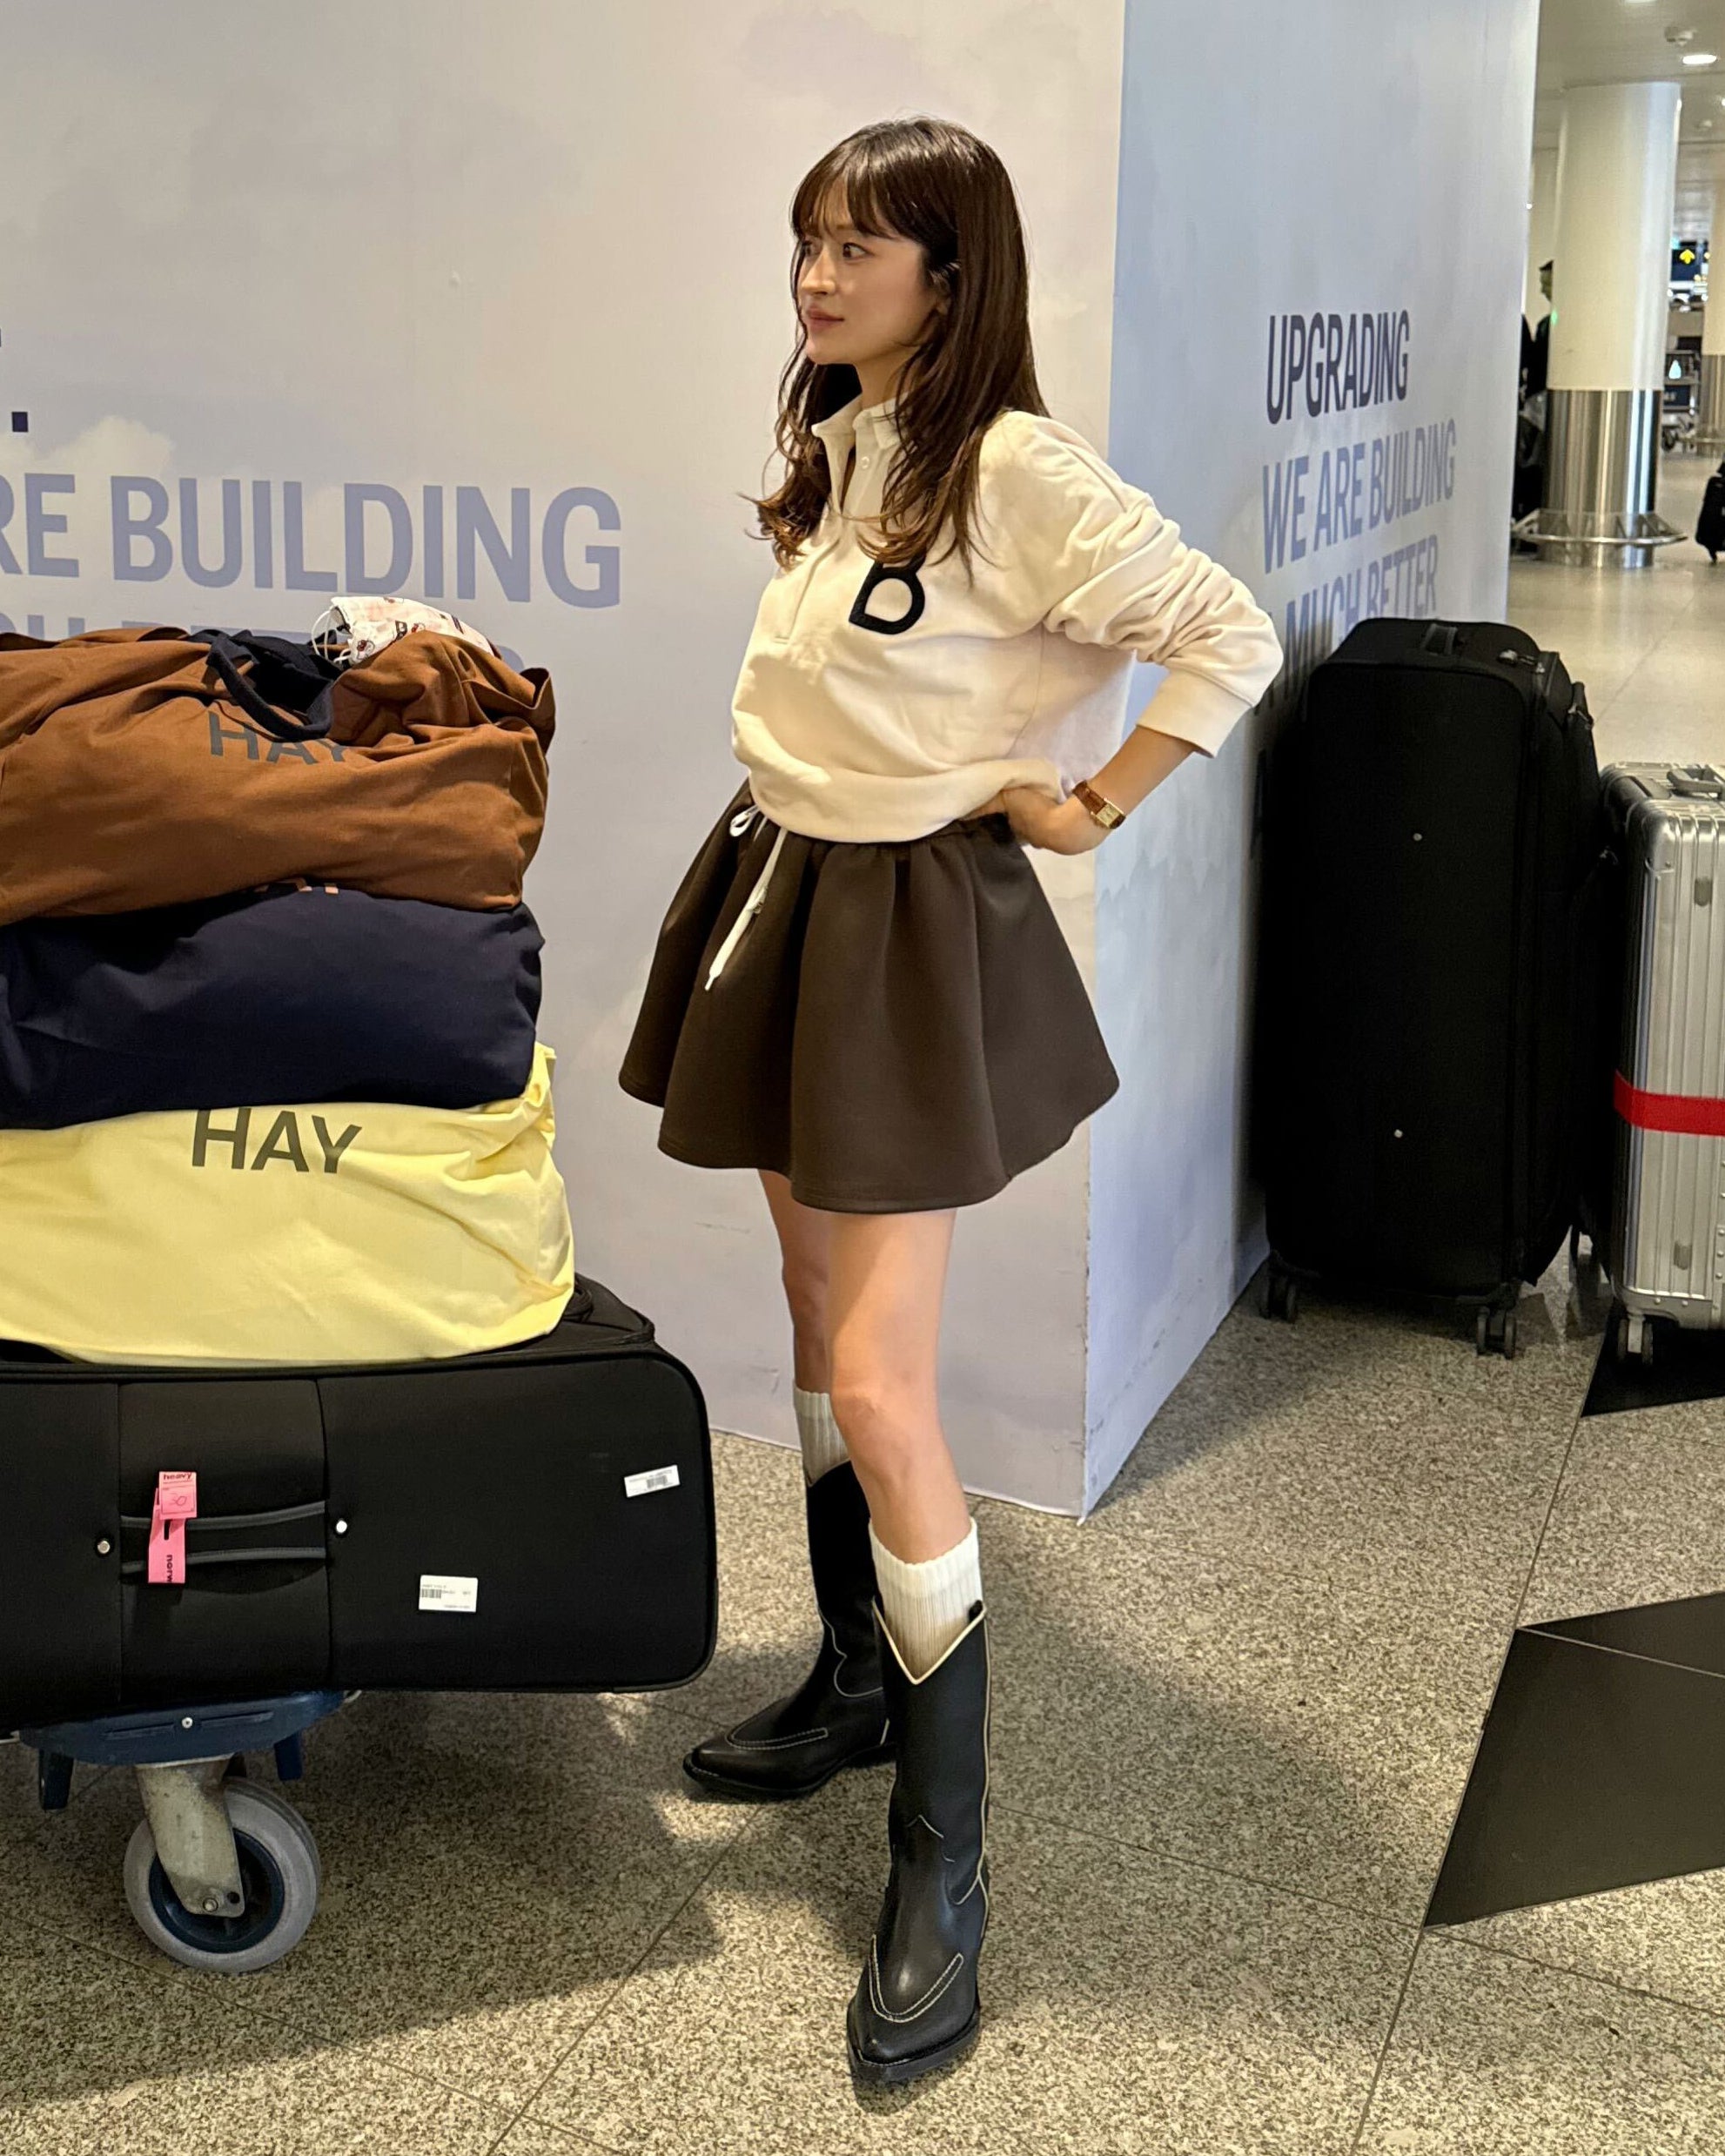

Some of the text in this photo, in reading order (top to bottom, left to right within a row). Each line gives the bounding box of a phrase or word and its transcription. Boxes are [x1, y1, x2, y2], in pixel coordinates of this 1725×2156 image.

[1266, 310, 1410, 424] UPGRADING
[110, 475, 621, 609] BUILDING
[1263, 418, 1457, 574] WE ARE BUILDING
[191, 1108, 362, 1173] HAY
